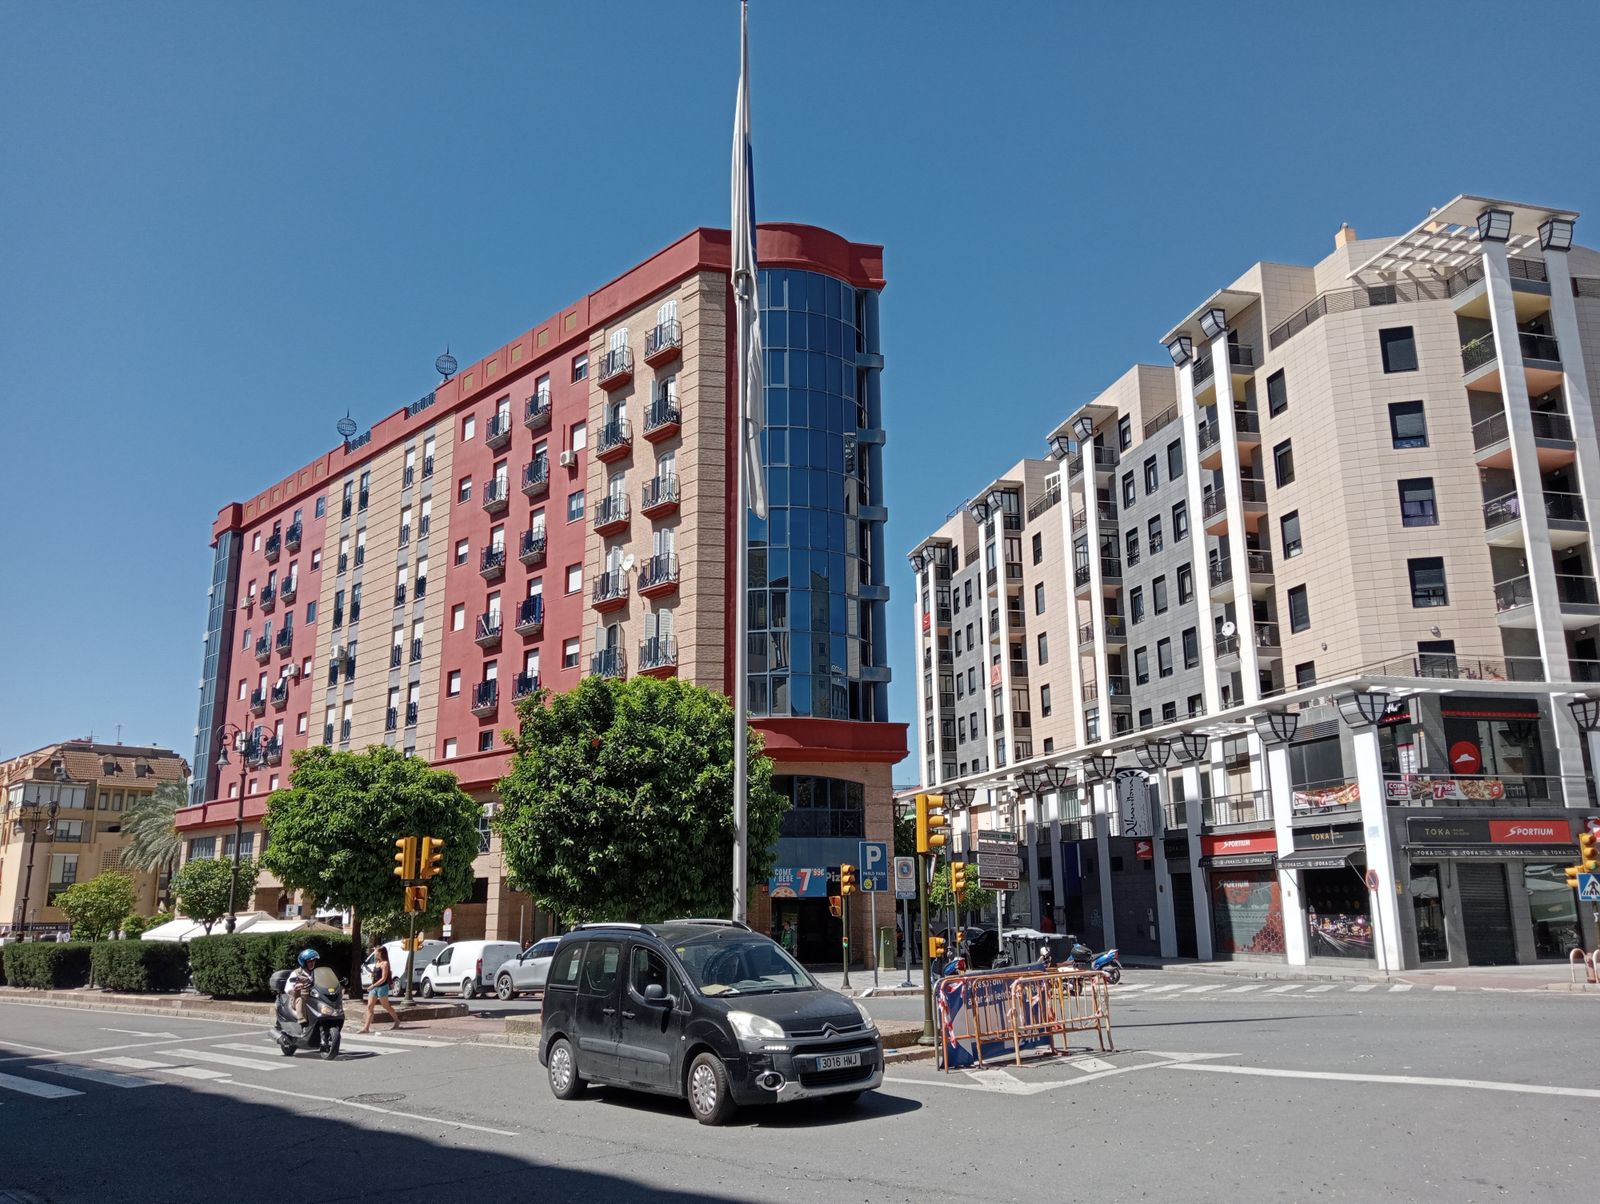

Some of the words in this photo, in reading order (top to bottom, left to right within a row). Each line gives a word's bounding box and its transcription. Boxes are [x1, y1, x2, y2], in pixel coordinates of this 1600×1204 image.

[1424, 828, 1451, 836] TOKA
[1504, 826, 1554, 838] SPORTIUM
[1221, 840, 1251, 850] SPORTIUM
[866, 845, 882, 870] P
[822, 1057, 841, 1069] 3016
[844, 1054, 857, 1066] HMJ
